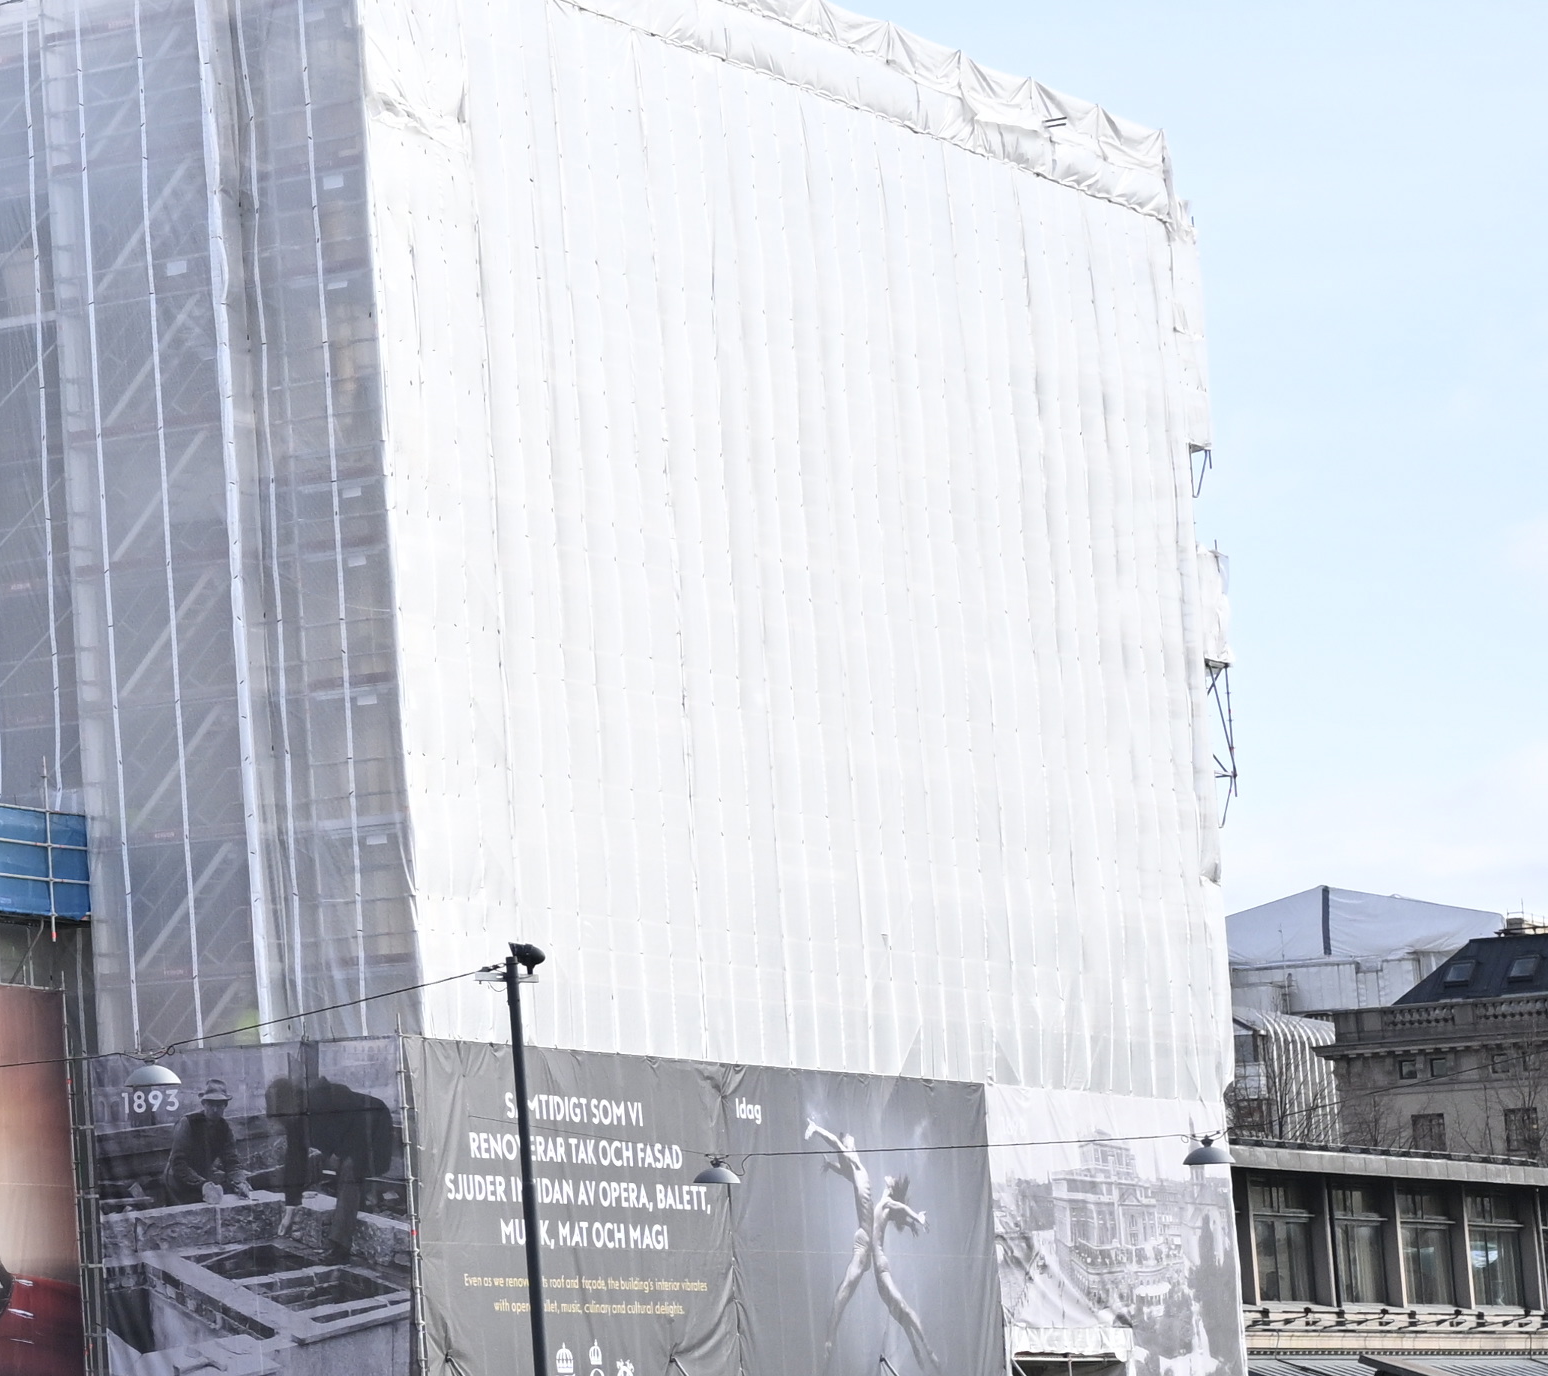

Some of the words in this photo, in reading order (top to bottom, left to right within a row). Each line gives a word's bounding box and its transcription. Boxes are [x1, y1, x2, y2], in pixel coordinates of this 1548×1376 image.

[121, 1089, 180, 1114] 1893
[505, 1092, 588, 1123] SMTIDIGT
[592, 1098, 625, 1125] SOM
[627, 1101, 644, 1127] VI
[735, 1097, 762, 1124] Idag
[469, 1132, 566, 1163] RENOERAR
[569, 1140, 595, 1165] TAK
[599, 1140, 633, 1167] OCH
[638, 1143, 683, 1170] FASAD
[445, 1173, 507, 1203] SJUDER
[577, 1180, 596, 1206] AV
[599, 1181, 654, 1212] OPERA,
[656, 1184, 711, 1215] BALETT,
[500, 1218, 555, 1250] MUK,
[558, 1221, 588, 1249] MAT
[592, 1223, 626, 1249] OCH
[629, 1224, 669, 1250] MAGI
[464, 1274, 482, 1287] Even
[483, 1278, 493, 1287] as
[493, 1277, 505, 1287] we
[549, 1275, 565, 1289] roof
[566, 1276, 579, 1289] and
[608, 1278, 620, 1290] the
[620, 1277, 654, 1293] building's
[655, 1279, 681, 1292] interior
[681, 1278, 708, 1292] vibrates
[494, 1299, 510, 1312] with
[561, 1301, 583, 1314] music,
[584, 1301, 611, 1316] culinary
[611, 1301, 626, 1314] and
[627, 1301, 653, 1314] cultural
[655, 1301, 685, 1317] delights.
